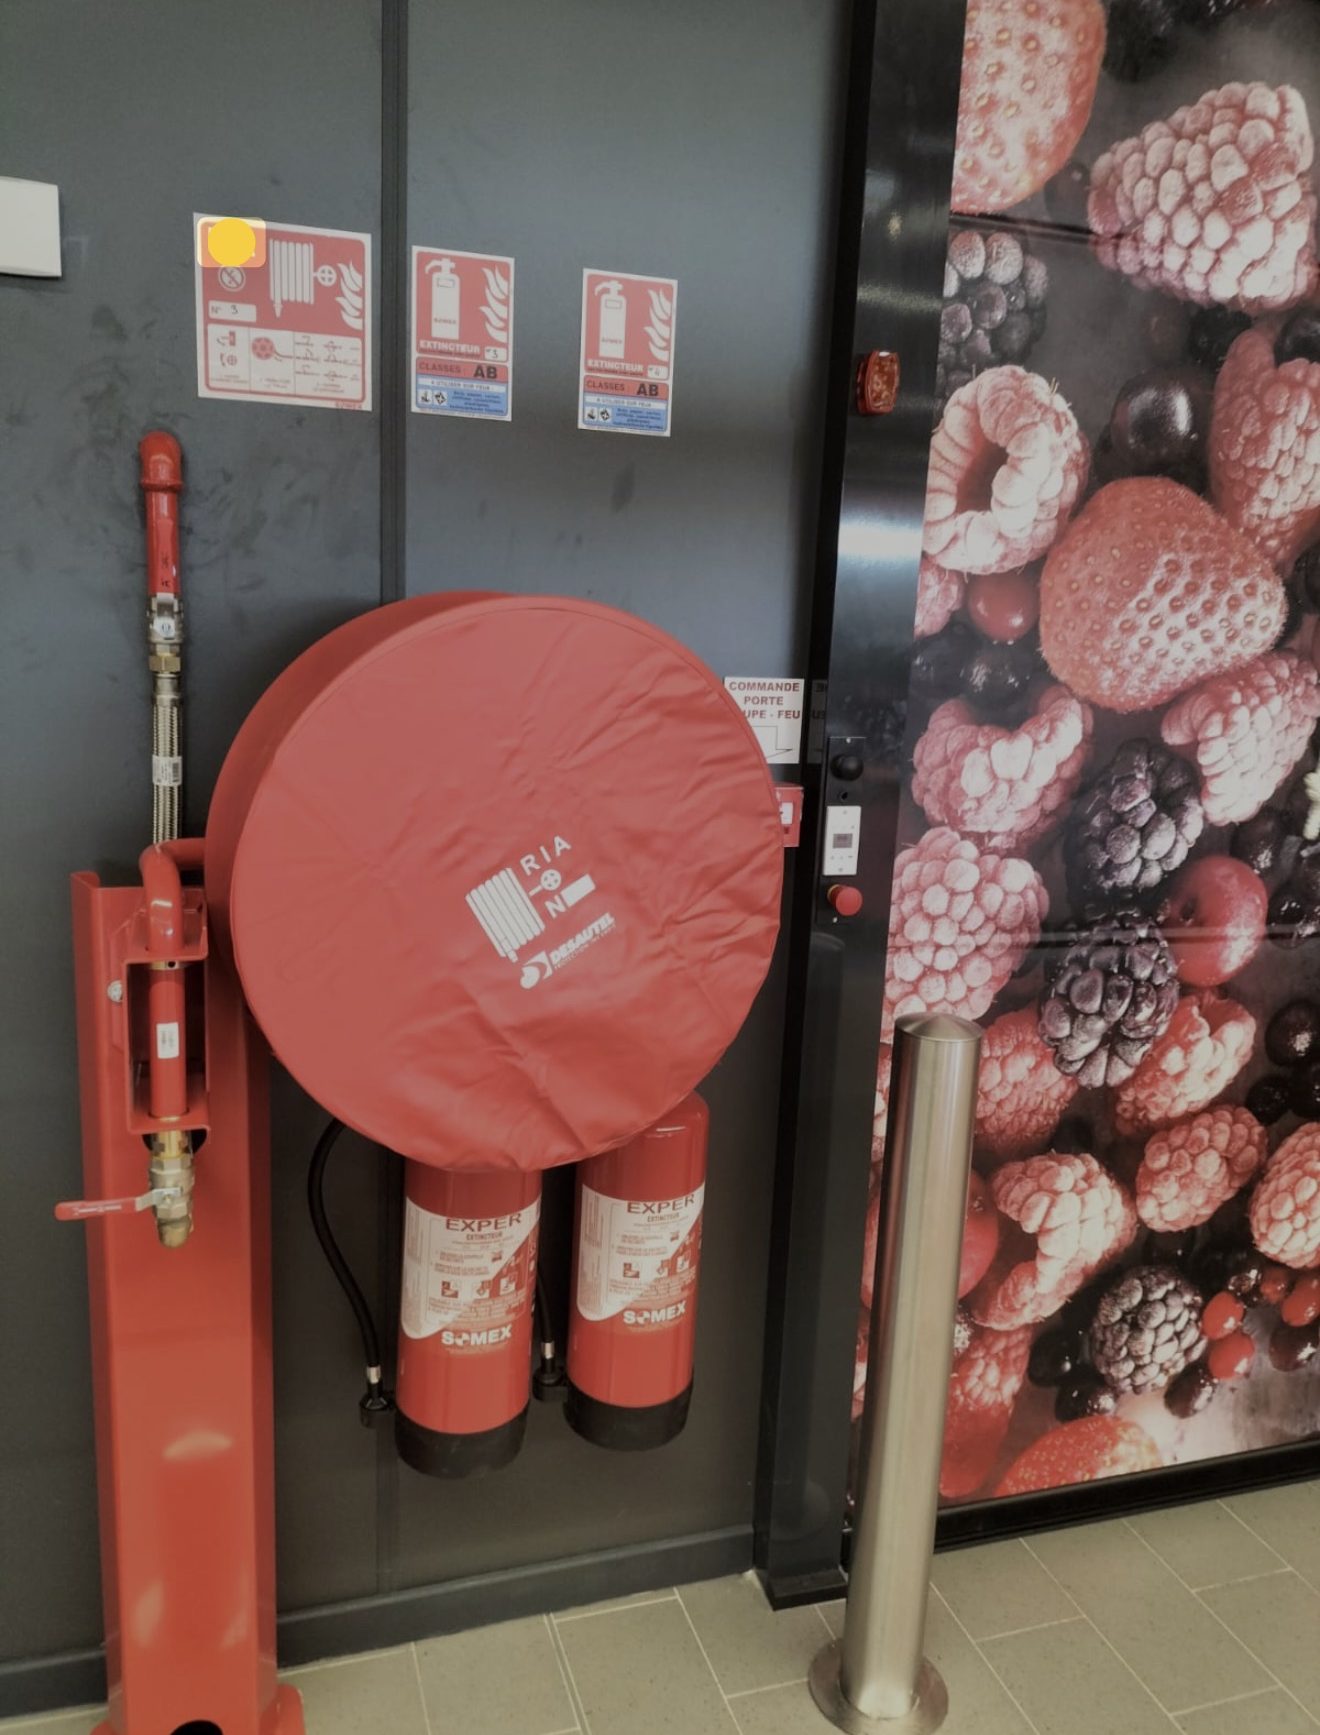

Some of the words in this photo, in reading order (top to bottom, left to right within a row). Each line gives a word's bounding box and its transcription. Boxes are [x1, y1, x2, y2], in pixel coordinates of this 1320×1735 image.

[420, 340, 480, 353] EXTINCTEUR
[418, 361, 461, 373] CLASSES
[473, 364, 497, 379] AB
[586, 359, 644, 372] EXTINCTEUR
[586, 379, 625, 391] CLASSES
[636, 383, 659, 397] AB
[729, 681, 800, 692] COMMANDE
[743, 695, 784, 706] PORTE
[744, 709, 767, 719] UPE
[777, 709, 801, 719] FEU
[520, 835, 572, 876] RIA
[549, 912, 615, 965] DESAUTEL
[627, 1193, 695, 1214] EXPER
[445, 1212, 523, 1233] EXPER
[465, 1231, 503, 1241] EXTINCTEUR
[623, 1300, 686, 1325] SOMEX
[441, 1324, 513, 1346] SOMEX
